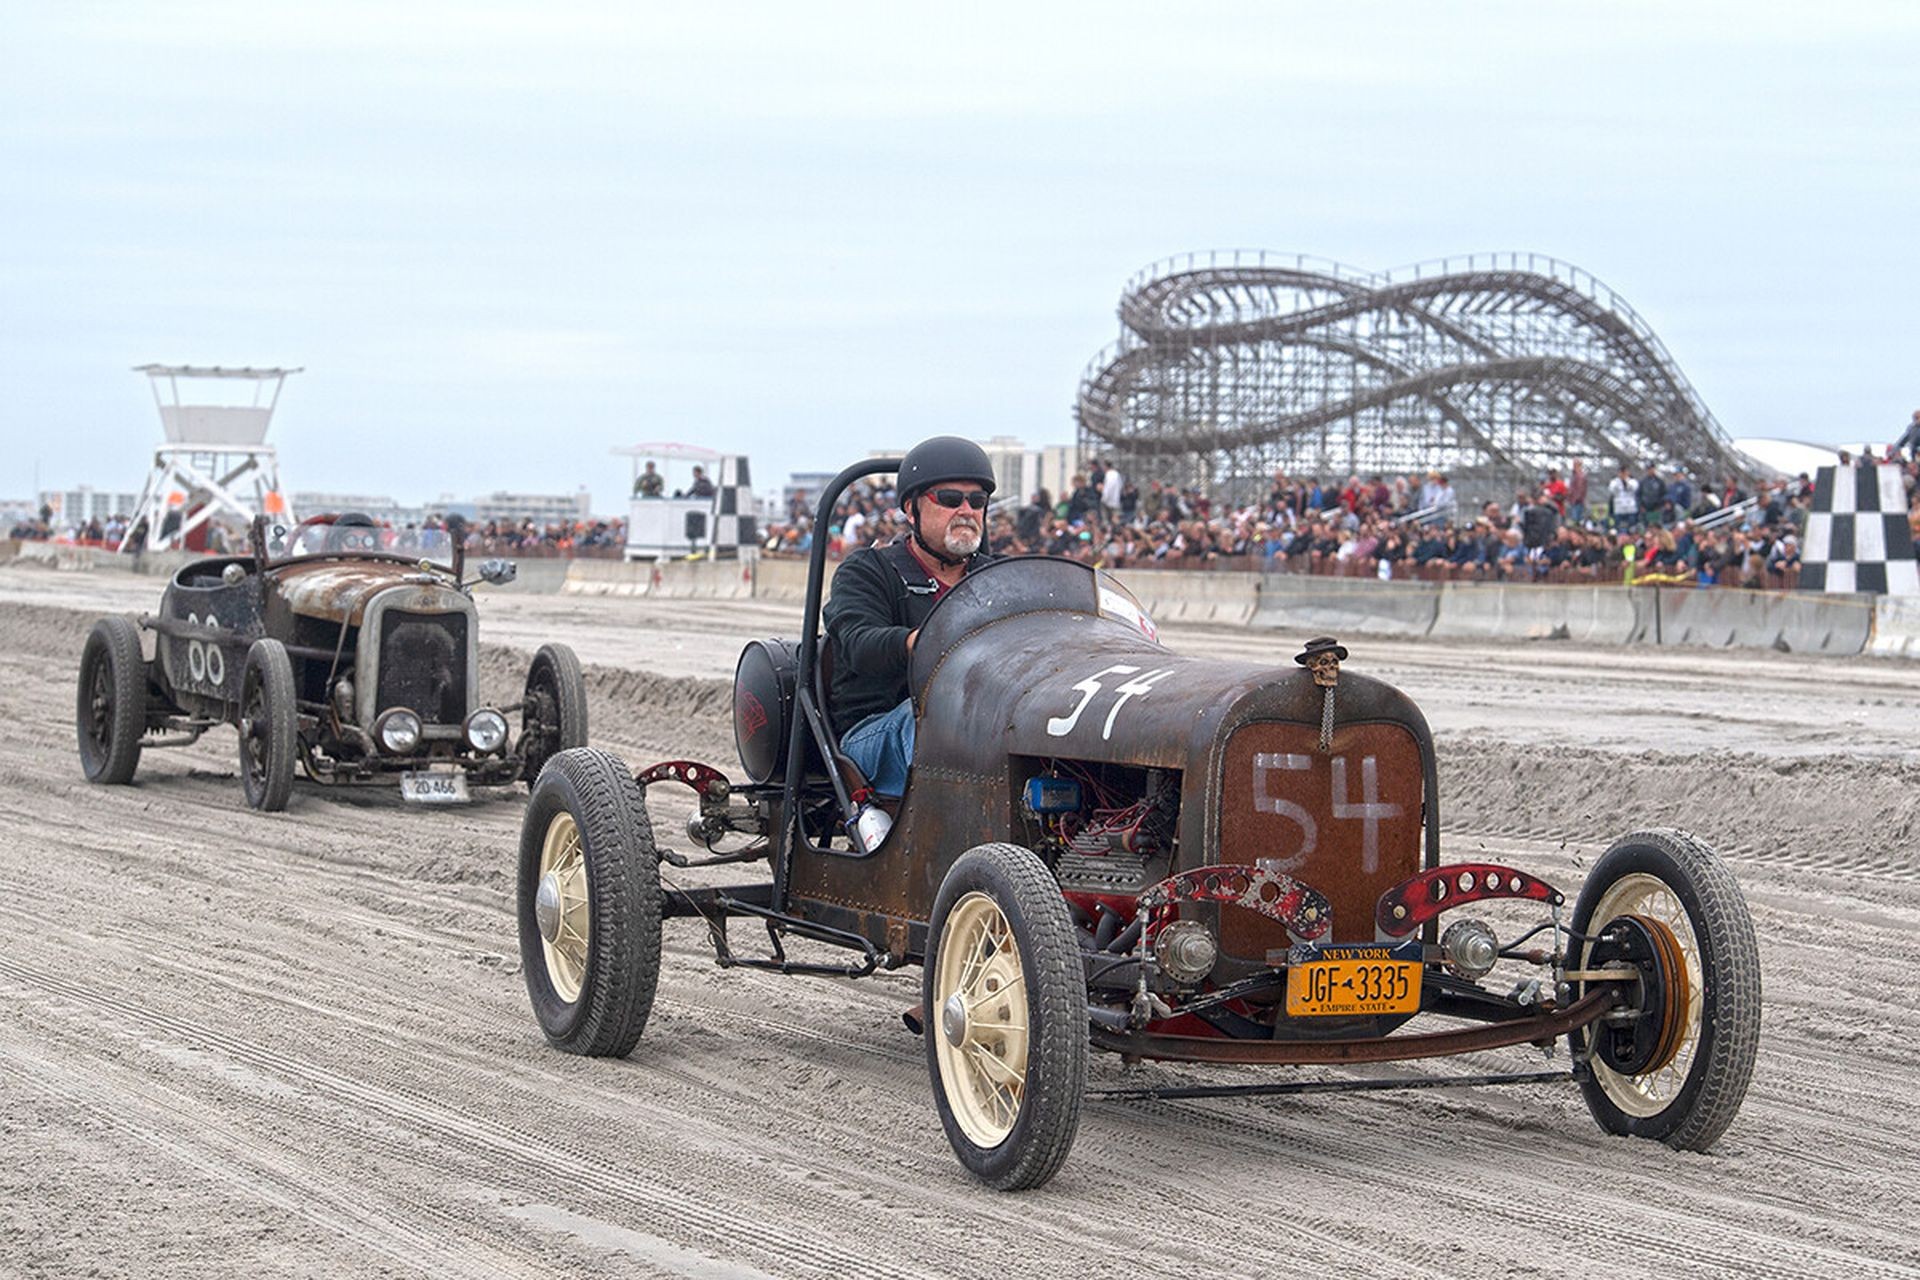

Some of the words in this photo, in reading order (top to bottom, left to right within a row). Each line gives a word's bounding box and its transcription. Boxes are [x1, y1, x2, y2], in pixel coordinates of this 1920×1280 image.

[1047, 664, 1175, 740] 54
[1253, 753, 1403, 874] 54
[1323, 949, 1353, 960] NEW
[1357, 948, 1391, 960] YORK
[1302, 967, 1340, 1002] JGF
[1356, 965, 1410, 1000] 3335
[1320, 1004, 1356, 1012] EMPIRE
[1360, 1003, 1388, 1011] STATE
